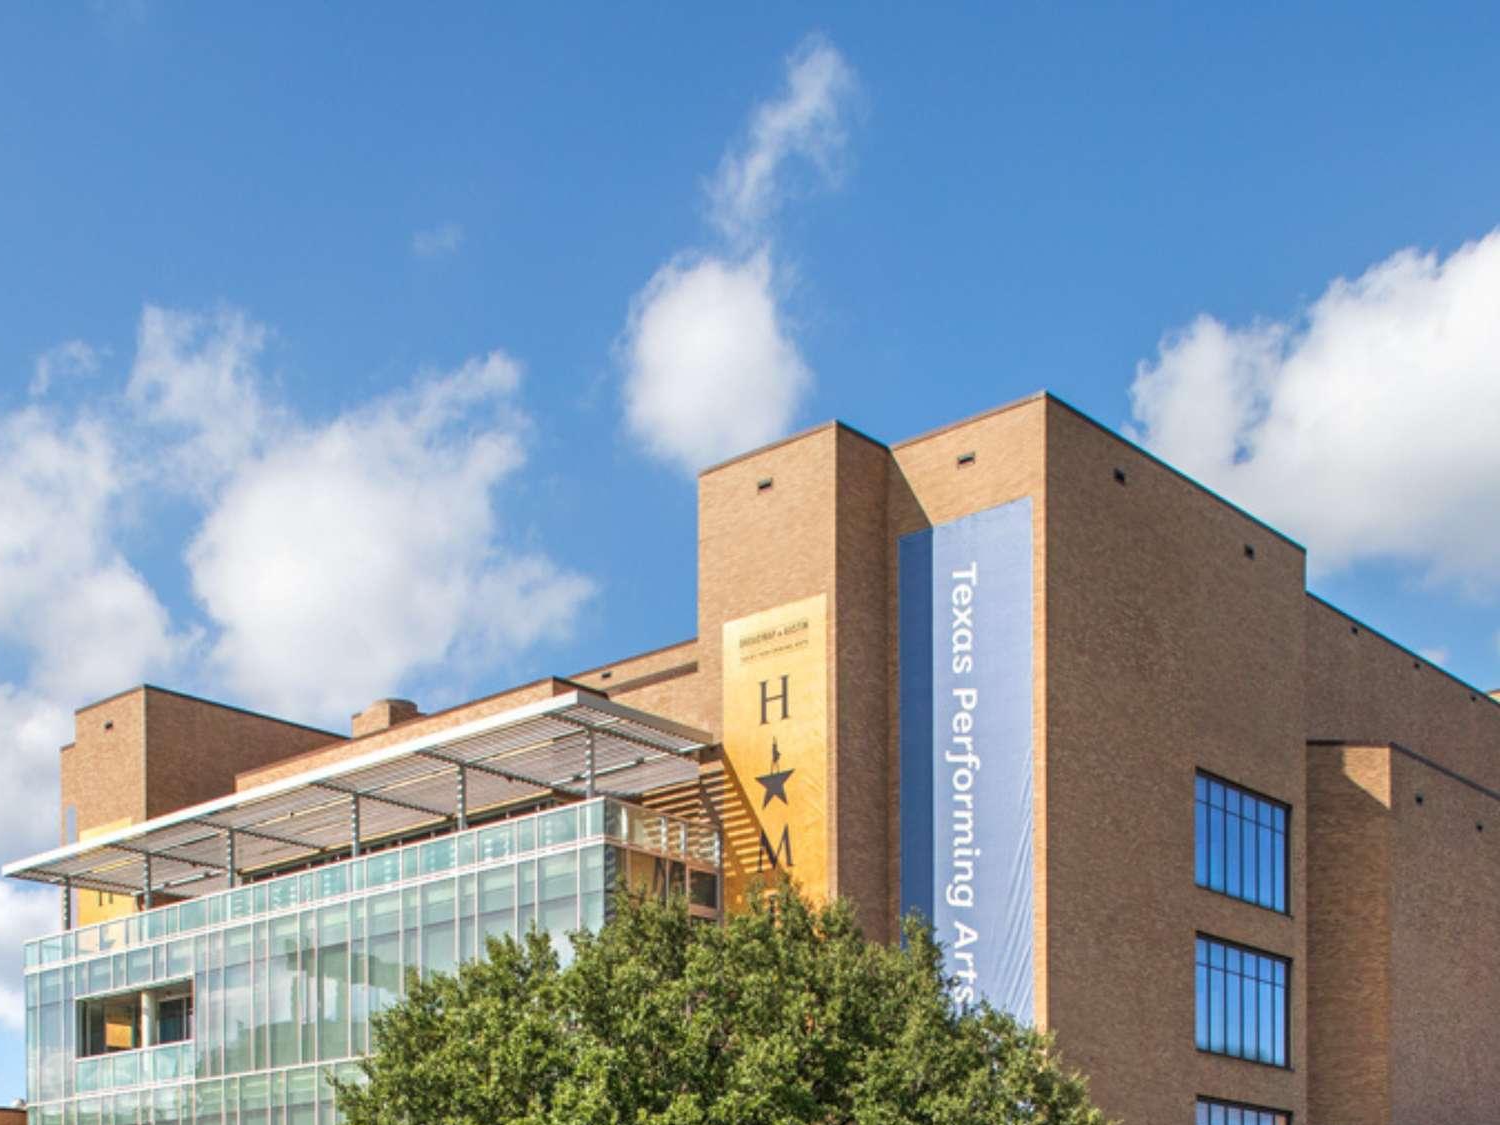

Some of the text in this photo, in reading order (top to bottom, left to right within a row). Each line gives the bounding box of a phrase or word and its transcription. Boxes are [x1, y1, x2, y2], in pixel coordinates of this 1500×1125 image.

[759, 674, 790, 725] H
[945, 560, 981, 1003] Texas Performing Arts
